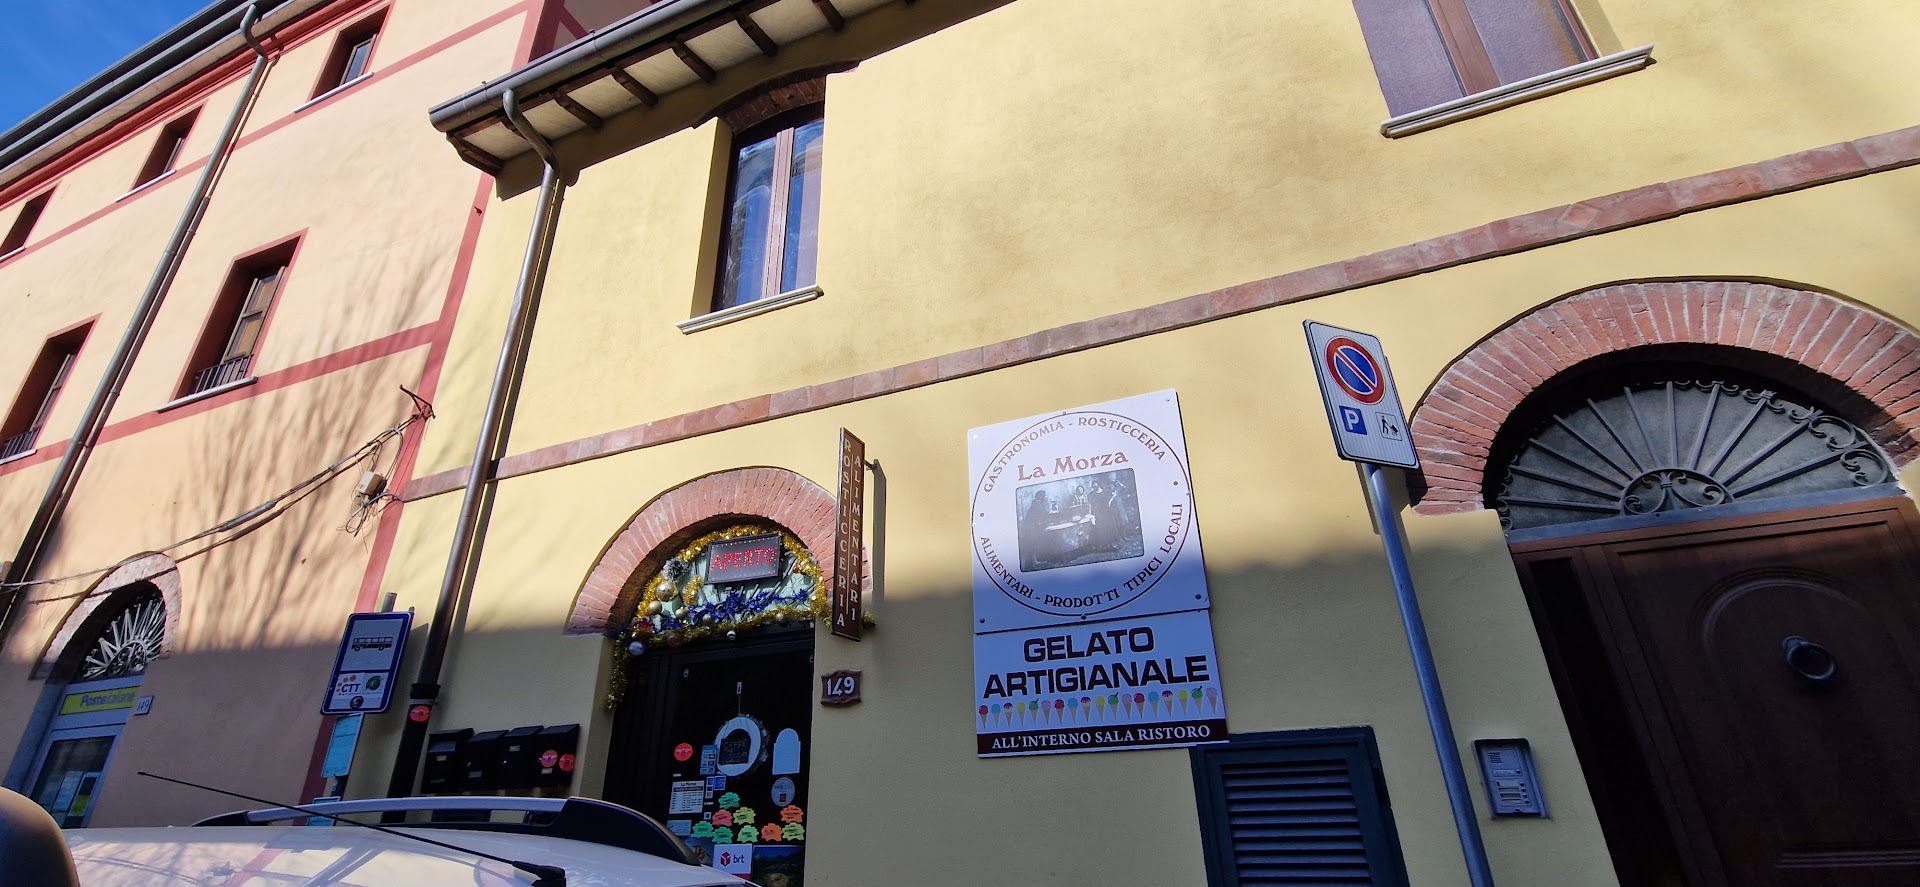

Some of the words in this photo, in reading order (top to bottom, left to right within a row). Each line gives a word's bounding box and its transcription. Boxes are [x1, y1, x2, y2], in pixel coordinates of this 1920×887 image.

[1344, 409, 1360, 430] P
[983, 421, 1065, 493] GASTRONOMIA
[1078, 417, 1166, 461] ROSTICCERIA
[1017, 464, 1046, 481] La
[1053, 451, 1129, 475] Morza
[836, 438, 851, 627] ROSTICCERIA
[850, 455, 862, 621] ALIMENTARI
[709, 547, 778, 572] APERTO
[980, 536, 1034, 600] ALIMENTARI
[1043, 589, 1120, 608] PRODOTTI
[1123, 556, 1163, 592] TIPICI
[1160, 503, 1183, 554] LOCALI
[1023, 626, 1155, 663] GELATO
[341, 683, 361, 693] CTT
[826, 676, 856, 697] 149
[983, 655, 1210, 699] ARTIGIANALE
[991, 732, 1092, 749] ALL'INTERNO
[1095, 728, 1135, 743] SALA
[1137, 724, 1211, 741] RISTORO
[733, 854, 745, 863] brt
